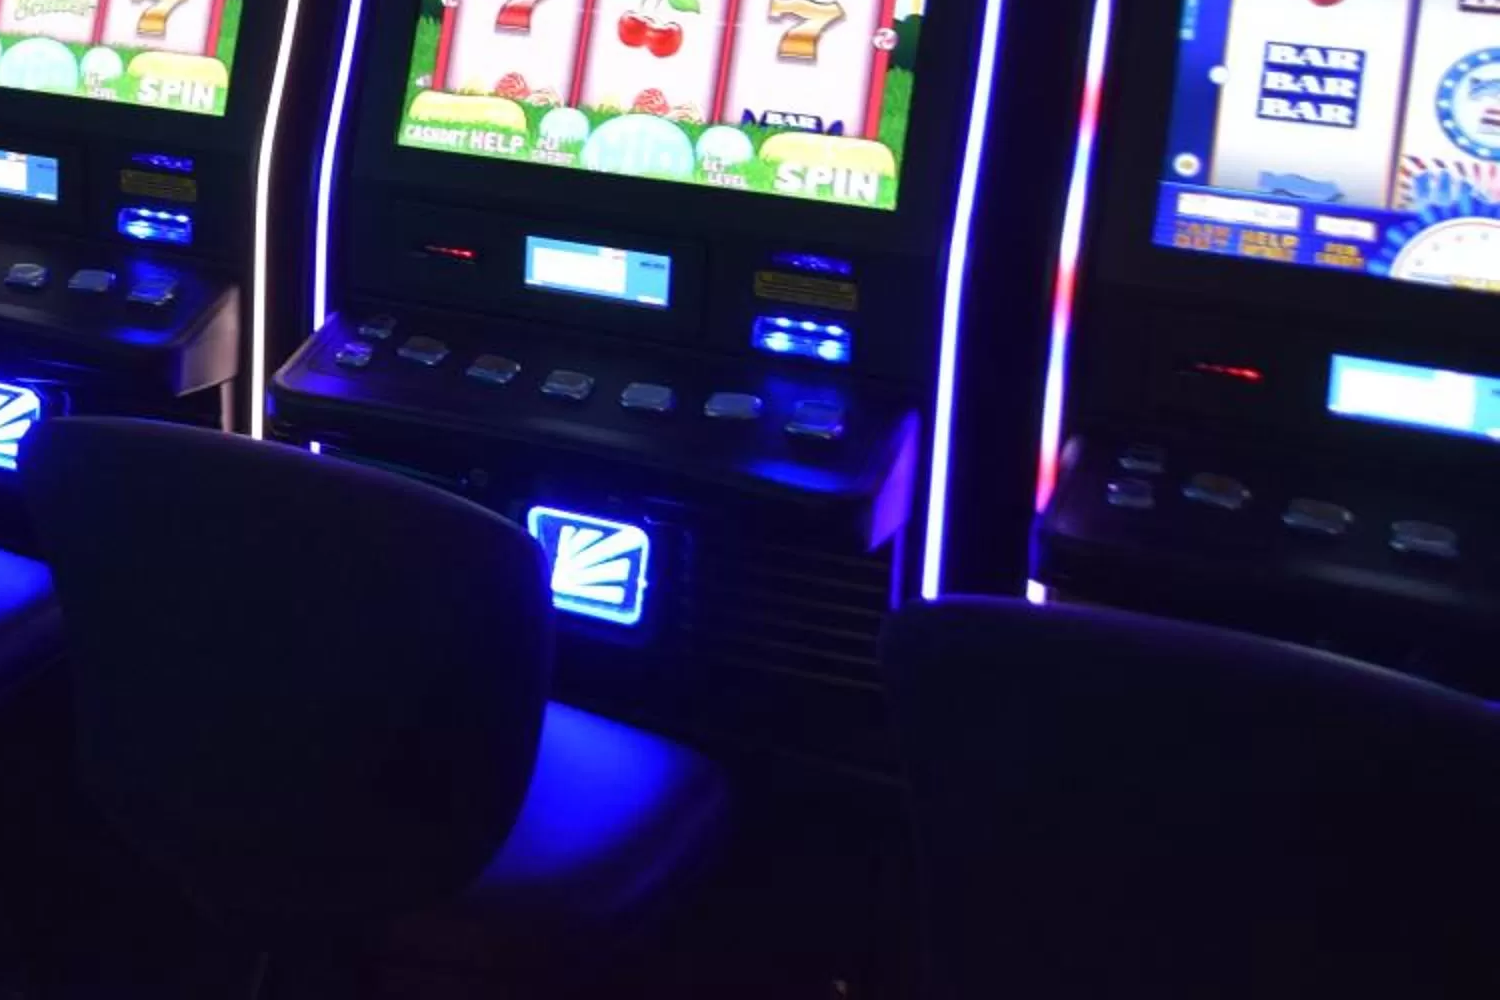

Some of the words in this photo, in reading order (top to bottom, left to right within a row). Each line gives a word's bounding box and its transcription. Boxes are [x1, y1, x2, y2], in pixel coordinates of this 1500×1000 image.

[1266, 43, 1361, 72] BAR
[137, 76, 216, 110] SPIN
[1263, 69, 1358, 98] BAR
[765, 112, 817, 129] BAR
[1259, 96, 1355, 126] BAR
[469, 129, 525, 154] HELP
[774, 160, 881, 205] SPIN
